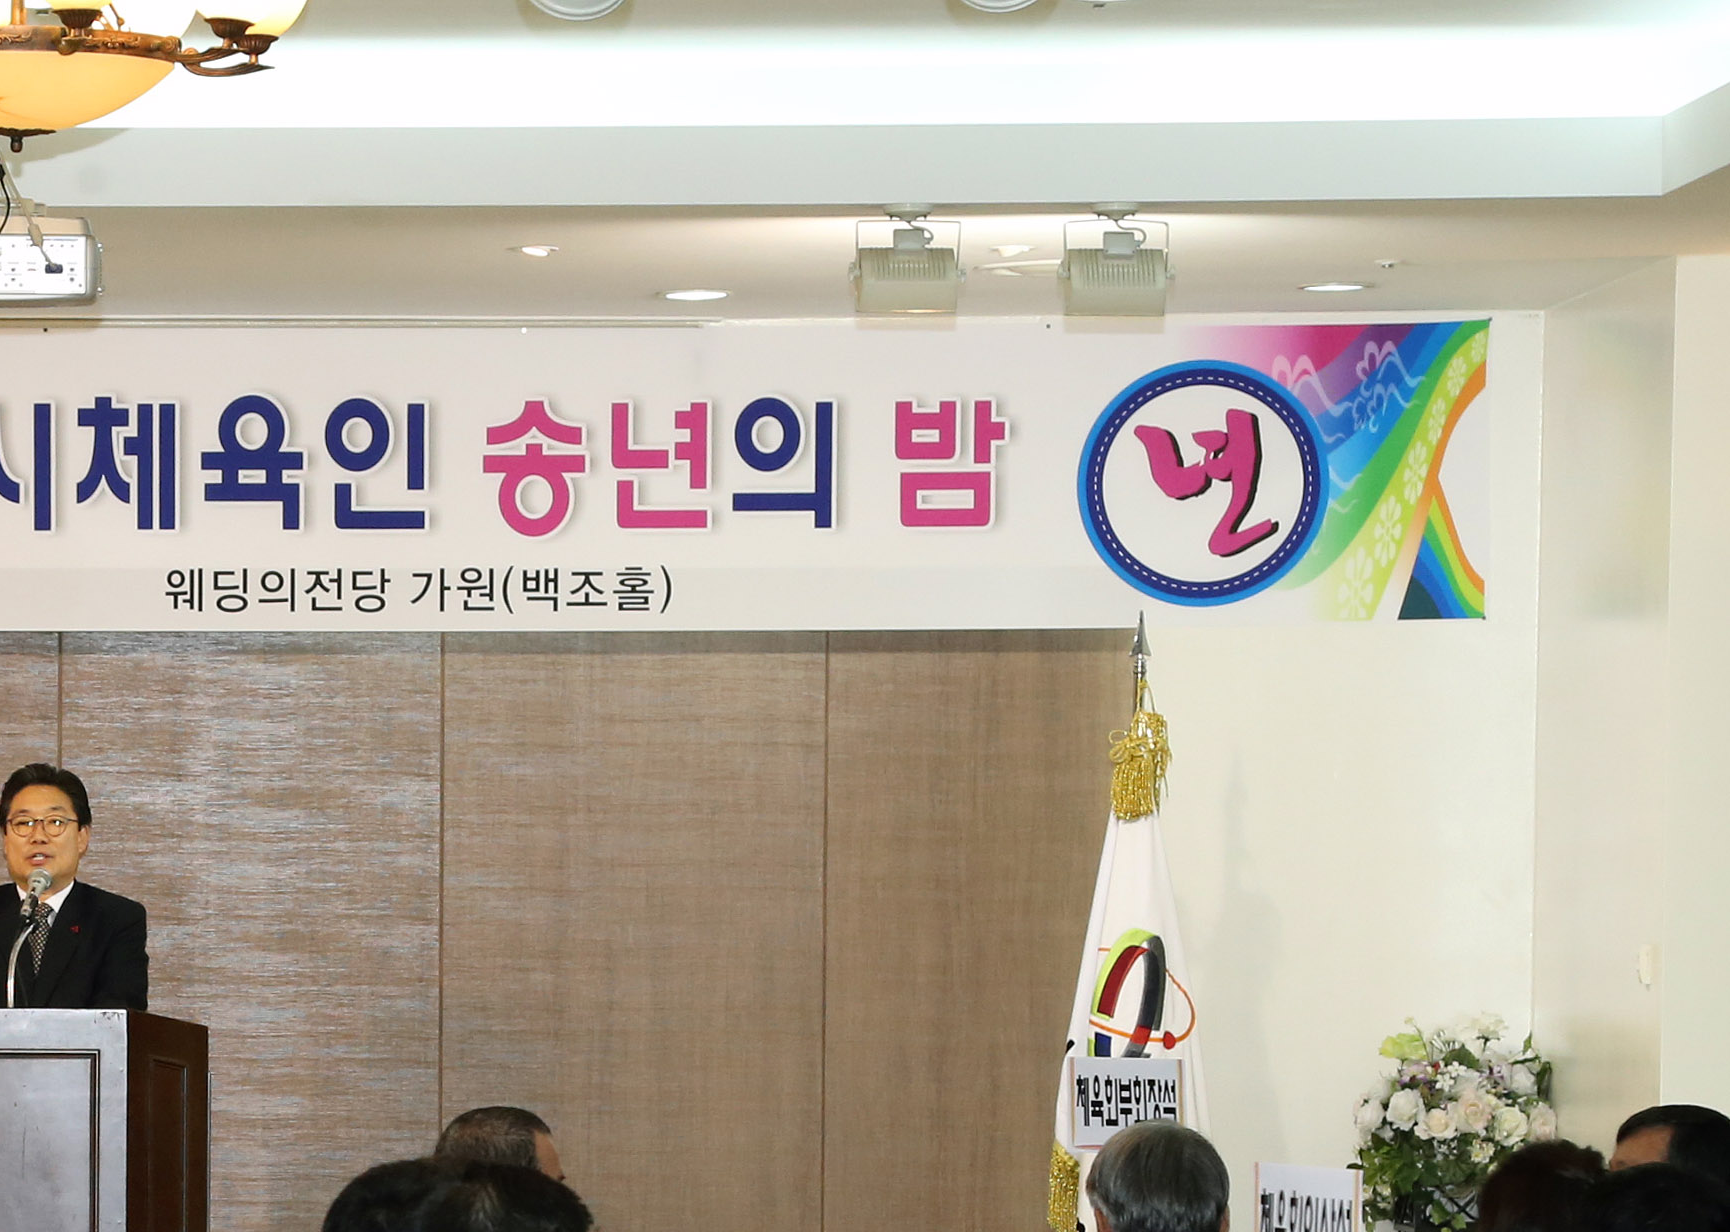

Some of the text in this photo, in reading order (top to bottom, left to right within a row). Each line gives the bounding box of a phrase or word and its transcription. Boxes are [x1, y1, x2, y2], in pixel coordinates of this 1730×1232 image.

[483, 398, 833, 534] 송년의
[897, 400, 1006, 530] 밤
[1134, 408, 1276, 556] 년
[164, 565, 672, 614] 웨딩의전당 가원(백조홀)
[1076, 1074, 1177, 1127] 체육회부회장석
